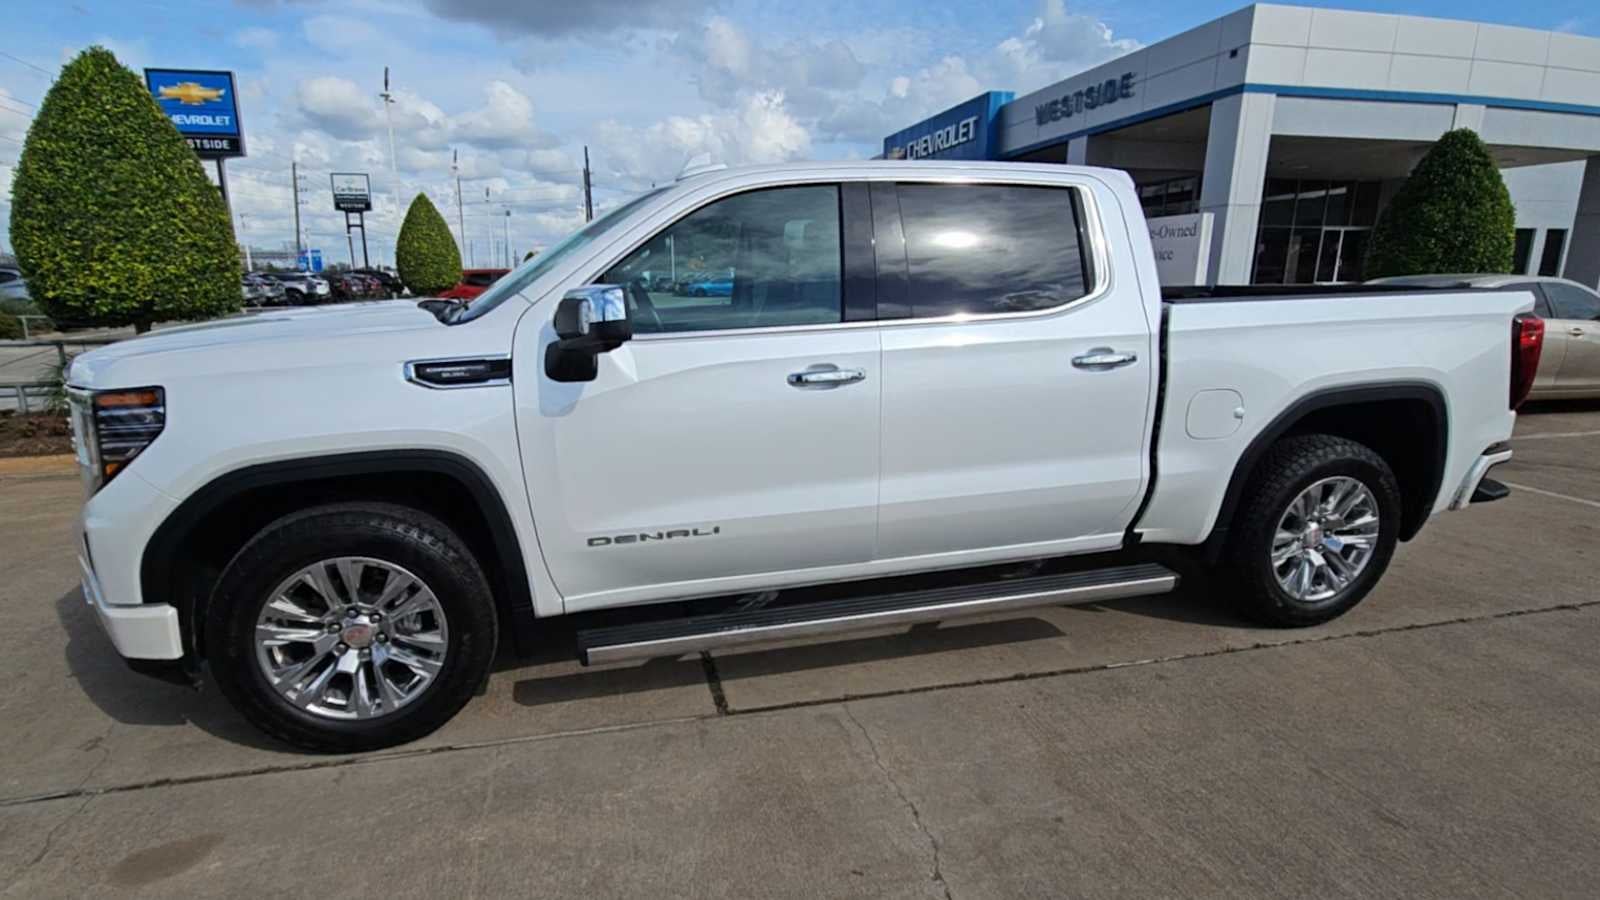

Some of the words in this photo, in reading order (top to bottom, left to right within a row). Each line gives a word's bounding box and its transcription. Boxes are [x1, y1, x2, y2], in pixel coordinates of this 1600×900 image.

[1035, 72, 1137, 127] WESTSIDE
[171, 113, 230, 126] HEVROLET
[186, 138, 231, 150] STSIDE
[906, 115, 979, 160] CHEVROLET
[1150, 222, 1197, 239] e-Owned
[587, 526, 721, 547] DENALI
